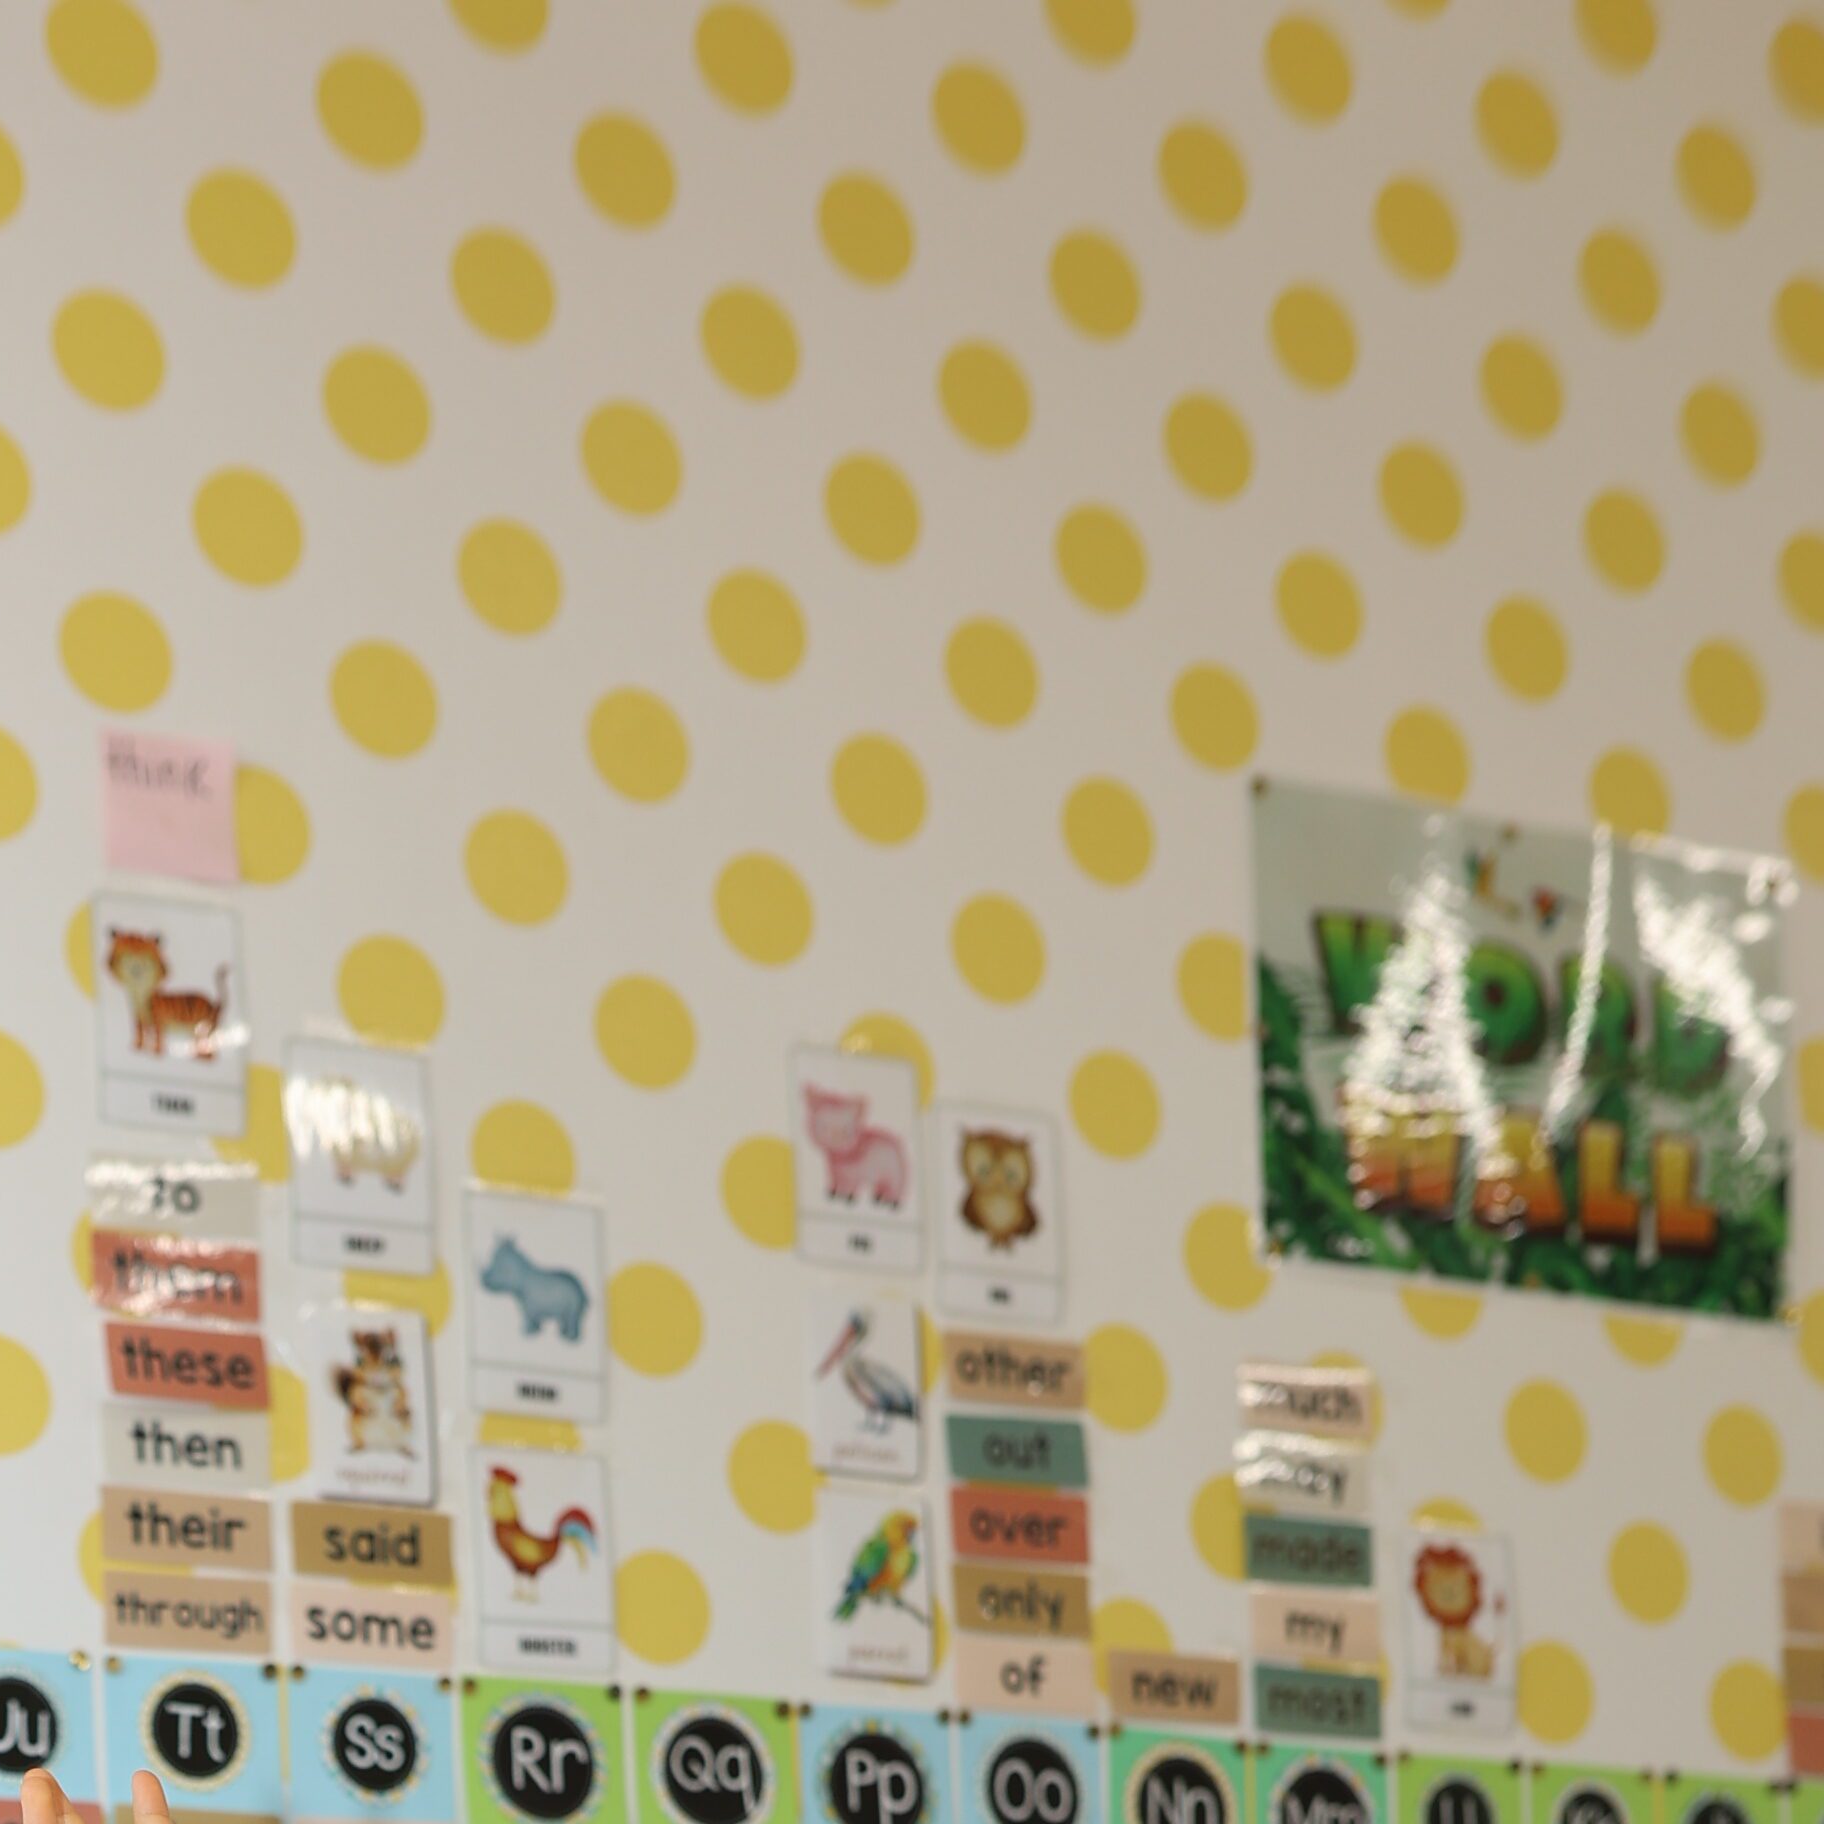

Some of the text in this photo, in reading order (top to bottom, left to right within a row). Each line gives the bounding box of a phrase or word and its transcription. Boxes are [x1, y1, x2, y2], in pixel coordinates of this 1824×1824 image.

[122, 1338, 255, 1389] these
[956, 1347, 1072, 1393] other
[131, 1421, 242, 1469] then
[983, 1429, 1052, 1472] out
[126, 1500, 247, 1551] their
[323, 1526, 420, 1568] said
[970, 1505, 1081, 1550] over
[1251, 1530, 1361, 1575] made
[115, 1591, 263, 1639] through
[978, 1576, 1063, 1630] only
[307, 1606, 436, 1650] some
[1286, 1609, 1346, 1655] my
[1000, 1657, 1046, 1695] of
[1132, 1670, 1215, 1706] new
[1268, 1685, 1366, 1726] most
[164, 1701, 227, 1764] Tt
[344, 1715, 406, 1770] Ss
[510, 1725, 588, 1795] Rr
[669, 1735, 760, 1815] Qq
[994, 1758, 1073, 1824] Oo
